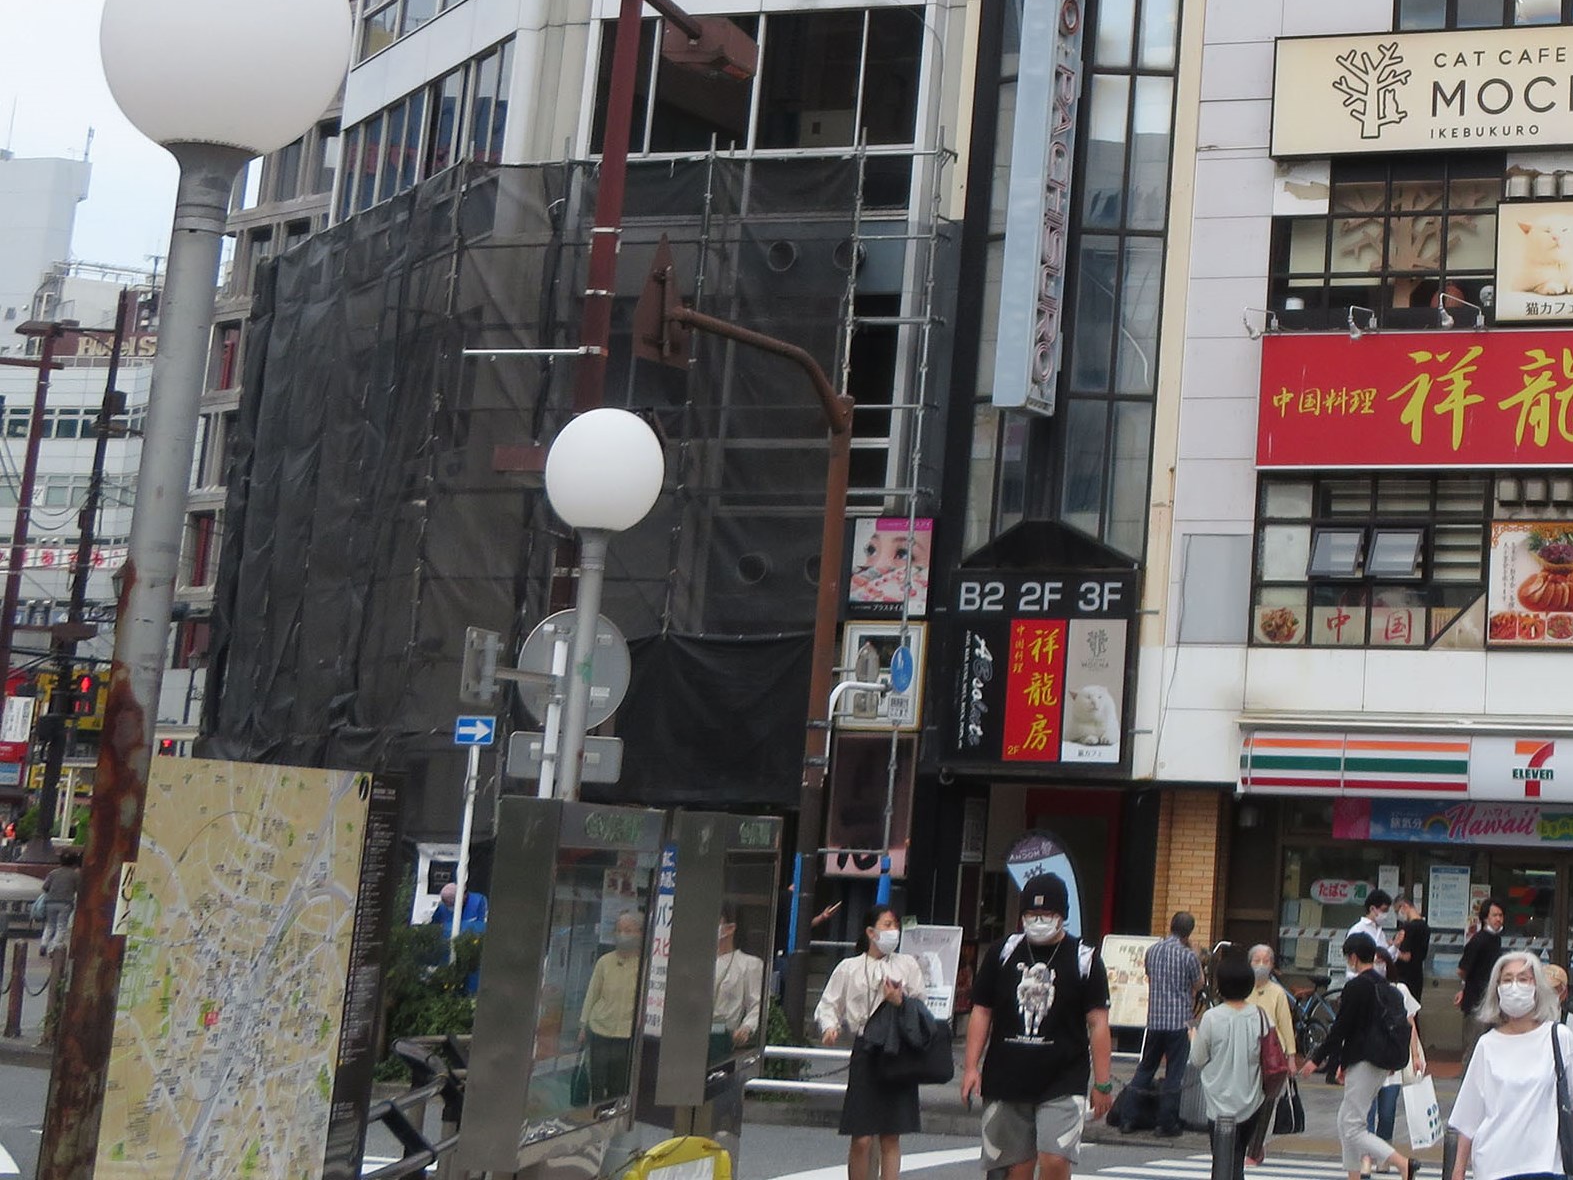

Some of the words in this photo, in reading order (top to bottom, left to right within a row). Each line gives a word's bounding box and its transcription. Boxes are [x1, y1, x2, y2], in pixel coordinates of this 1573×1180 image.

[1433, 48, 1486, 68] CAT
[1498, 45, 1568, 66] CAFE
[1430, 123, 1541, 140] IKEBUKURO
[1271, 385, 1379, 419] 中国料理
[959, 581, 1006, 612] B2
[1018, 581, 1063, 612] 2F
[1078, 581, 1123, 612] 3F
[1326, 608, 1413, 646] 中国
[1022, 627, 1060, 751] 祥龍房
[1007, 745, 1020, 756] 2F
[1446, 804, 1540, 839] Hawaii
[1318, 882, 1348, 899] たばこ
